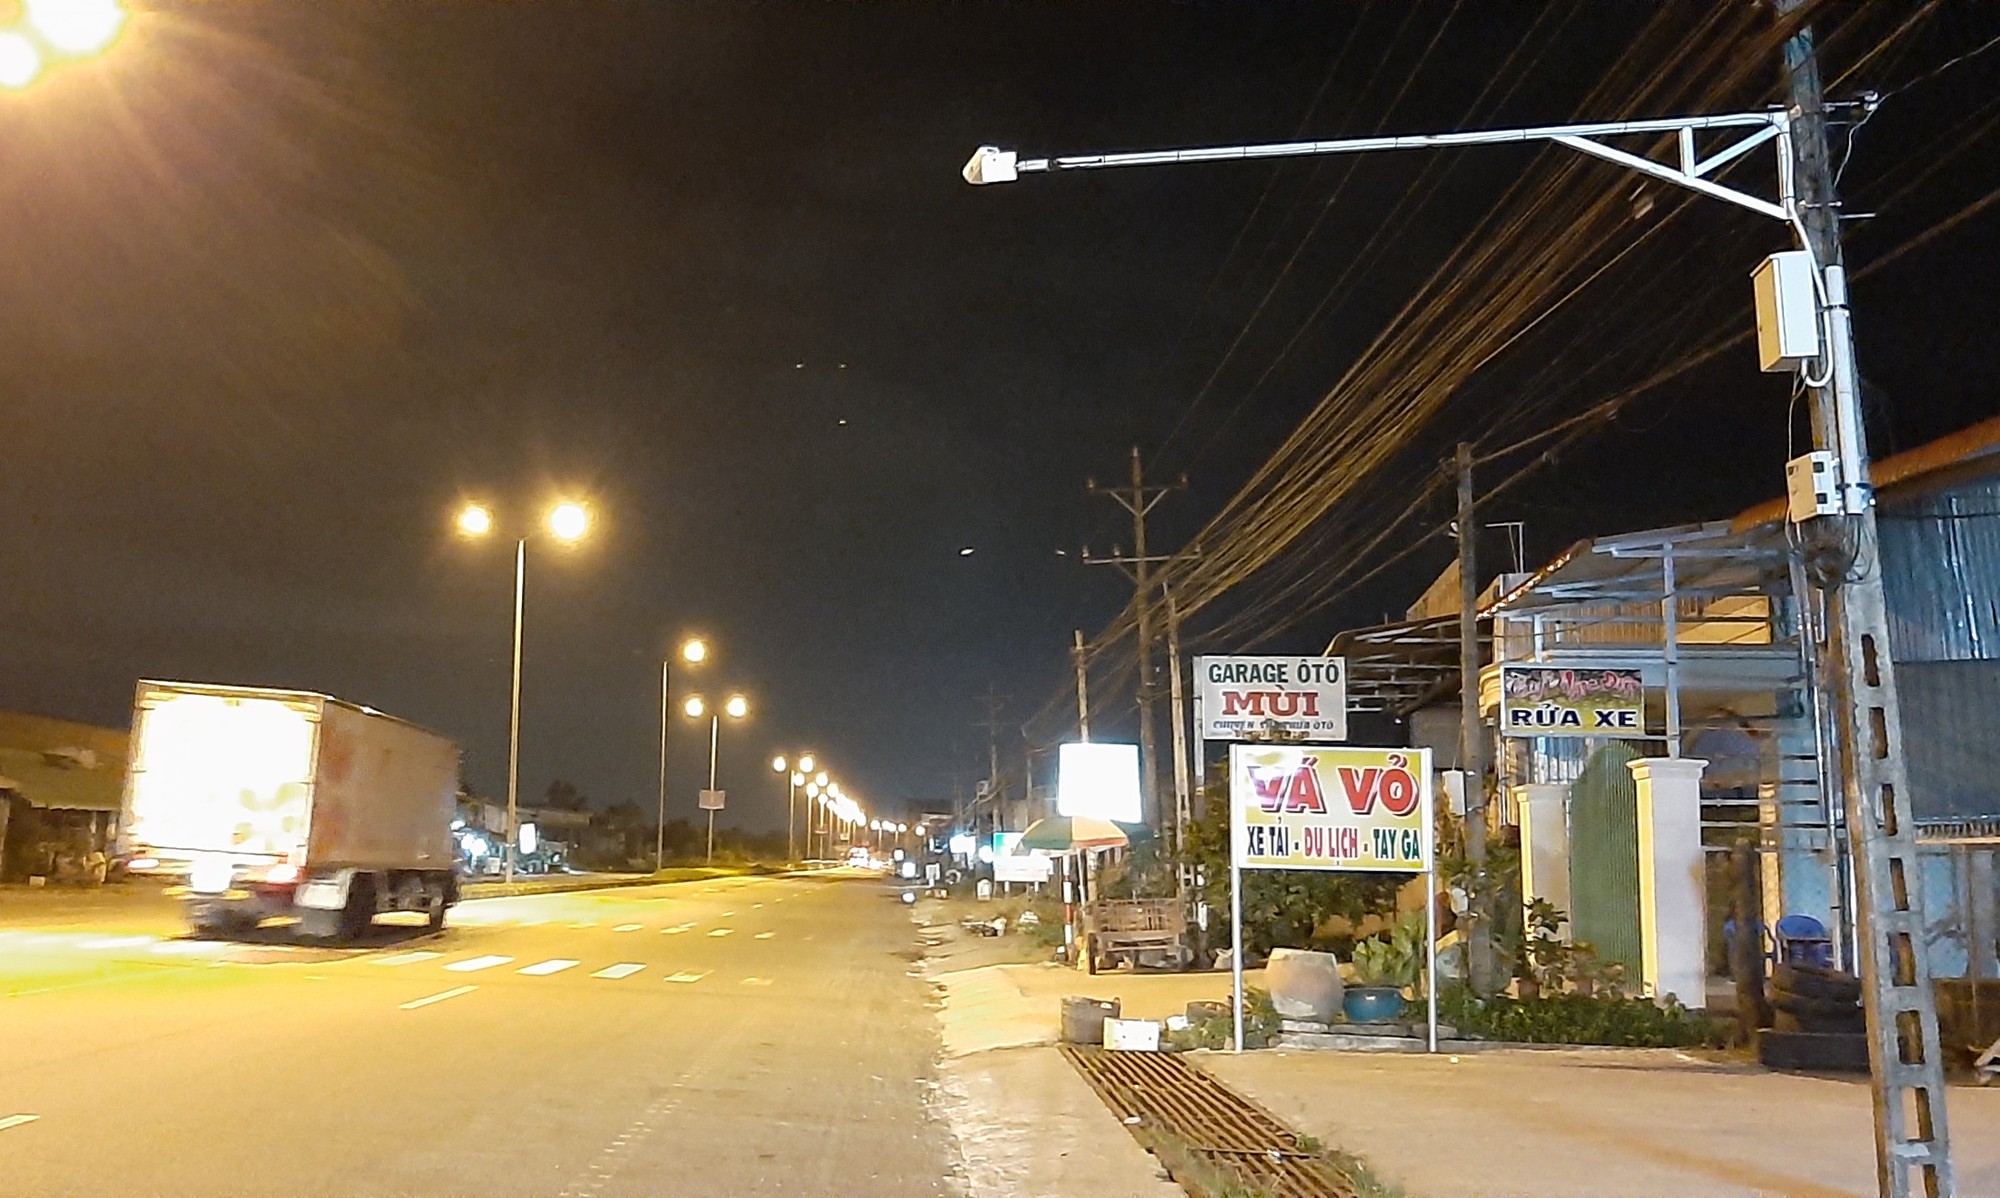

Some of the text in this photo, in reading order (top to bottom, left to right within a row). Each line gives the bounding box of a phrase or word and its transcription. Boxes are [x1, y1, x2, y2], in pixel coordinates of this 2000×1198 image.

[1208, 659, 1340, 683] GARAGE ÔTÔ
[1222, 684, 1320, 716] MÙI
[1511, 703, 1637, 728] RỬA XE
[1338, 753, 1420, 817] VỎ
[1247, 825, 1265, 856] XE
[1373, 828, 1397, 859] TAY
[1401, 829, 1421, 860] GA
